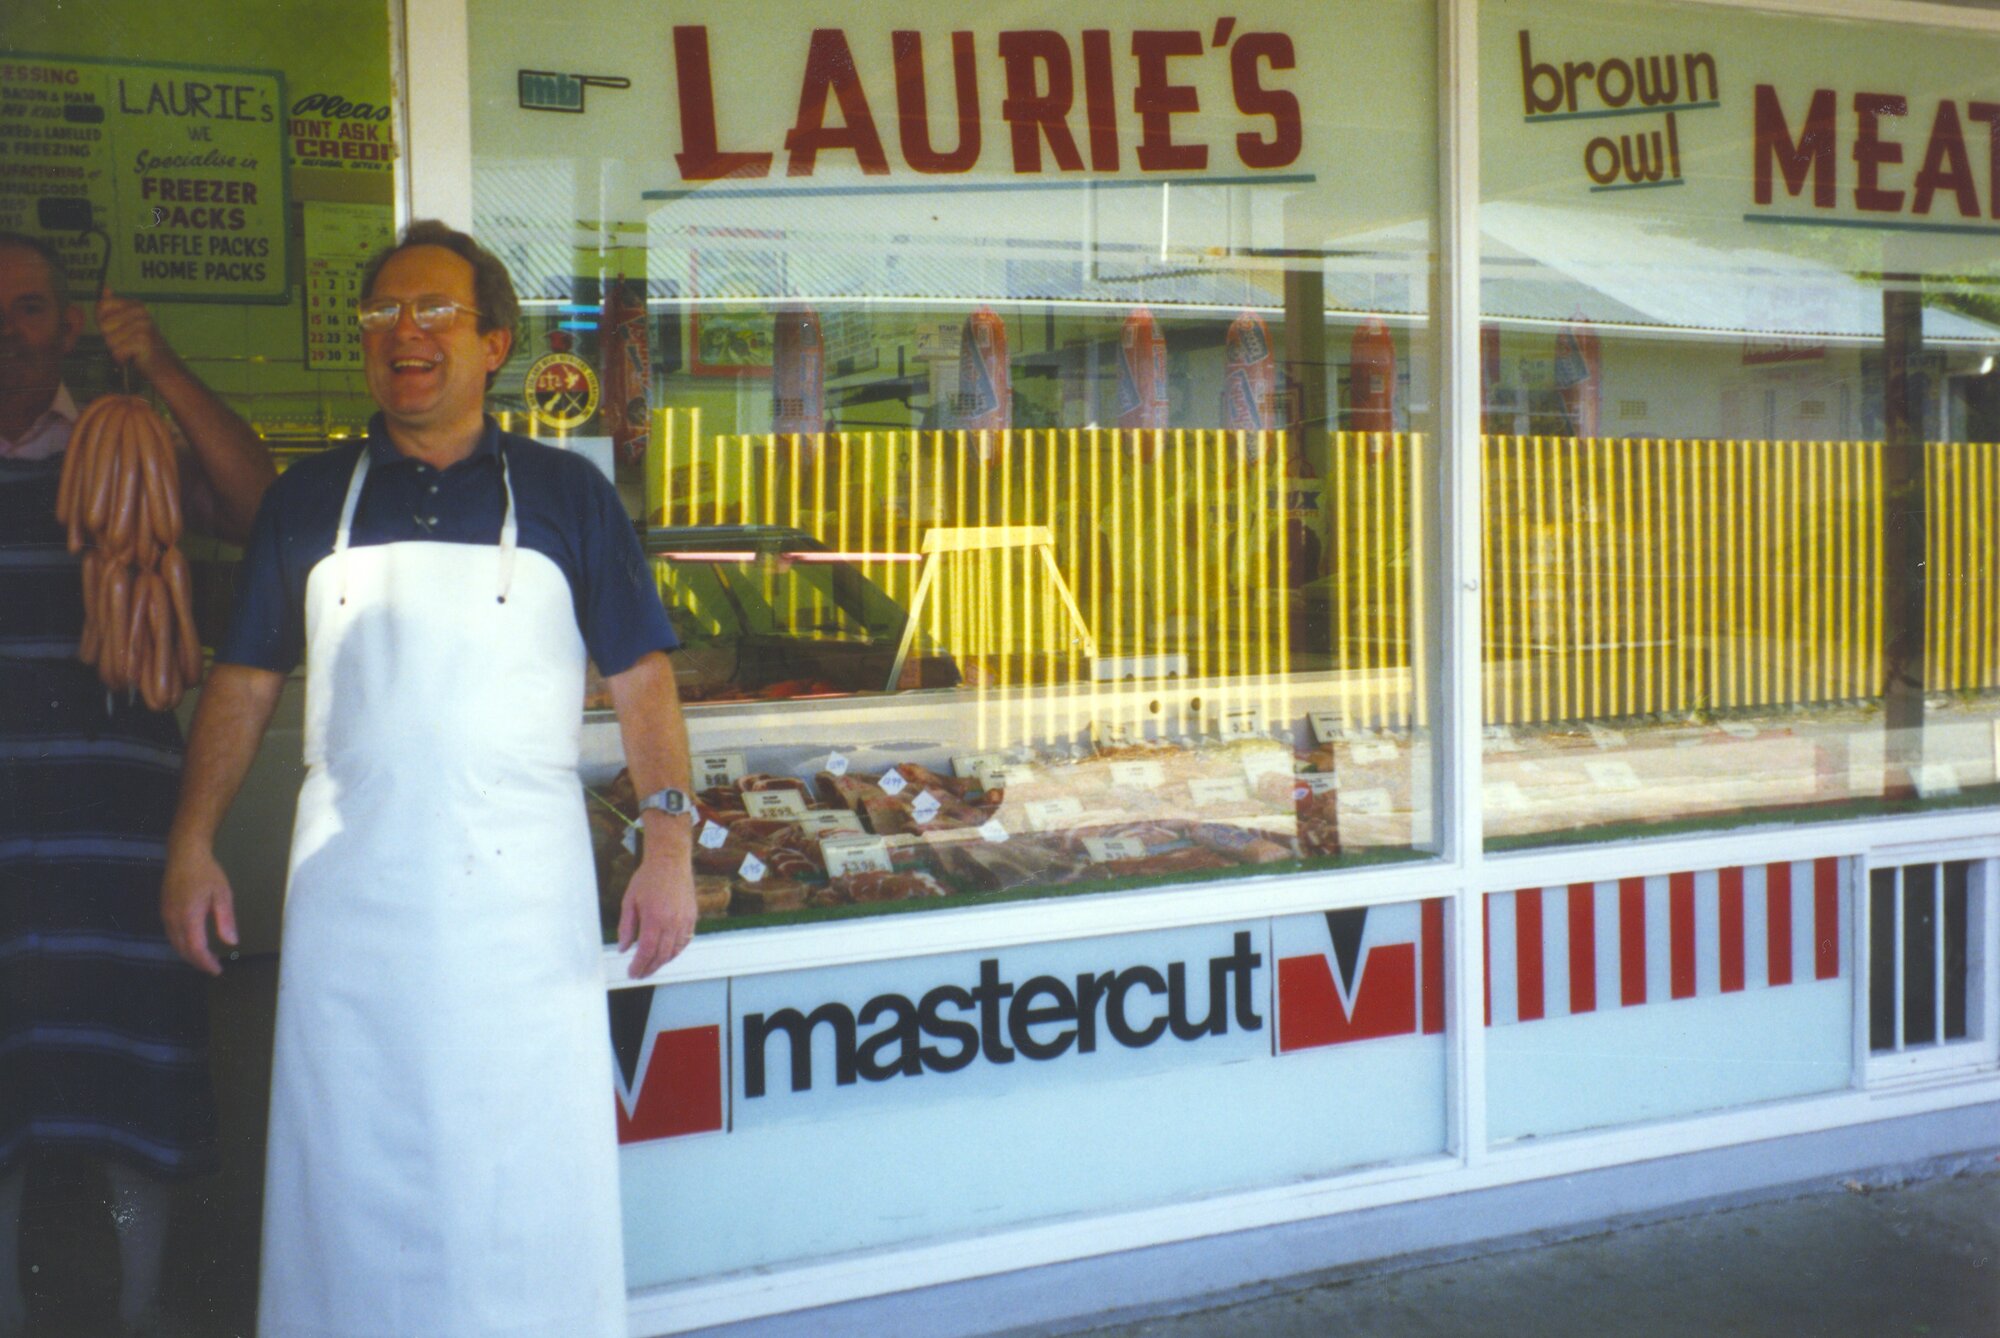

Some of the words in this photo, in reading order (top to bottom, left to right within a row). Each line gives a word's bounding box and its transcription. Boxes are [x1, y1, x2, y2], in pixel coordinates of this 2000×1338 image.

[1519, 29, 1719, 115] brown
[118, 78, 273, 123] LAURIE's
[673, 17, 1302, 181] LAURIE'S
[187, 125, 212, 142] WE
[339, 122, 379, 142] ASK
[15, 143, 90, 158] FREEZING
[296, 139, 393, 161] CREDI
[1585, 111, 1681, 184] owl
[133, 148, 236, 176] Specialise
[240, 152, 258, 169] in
[142, 176, 257, 205] FREEZER
[152, 205, 246, 230] PACKS
[134, 233, 203, 256] RAFFLE
[208, 236, 269, 257] PACKS
[141, 260, 198, 280] HOME
[204, 262, 266, 281] PACKS
[328, 279, 337, 291] 2
[347, 280, 356, 292] 3
[328, 296, 337, 308] 9
[328, 315, 340, 327] 16
[310, 333, 325, 345] 22
[327, 333, 342, 345] 23
[347, 333, 362, 345] 24
[327, 351, 343, 362] 30
[743, 930, 1263, 1099] mastercut
